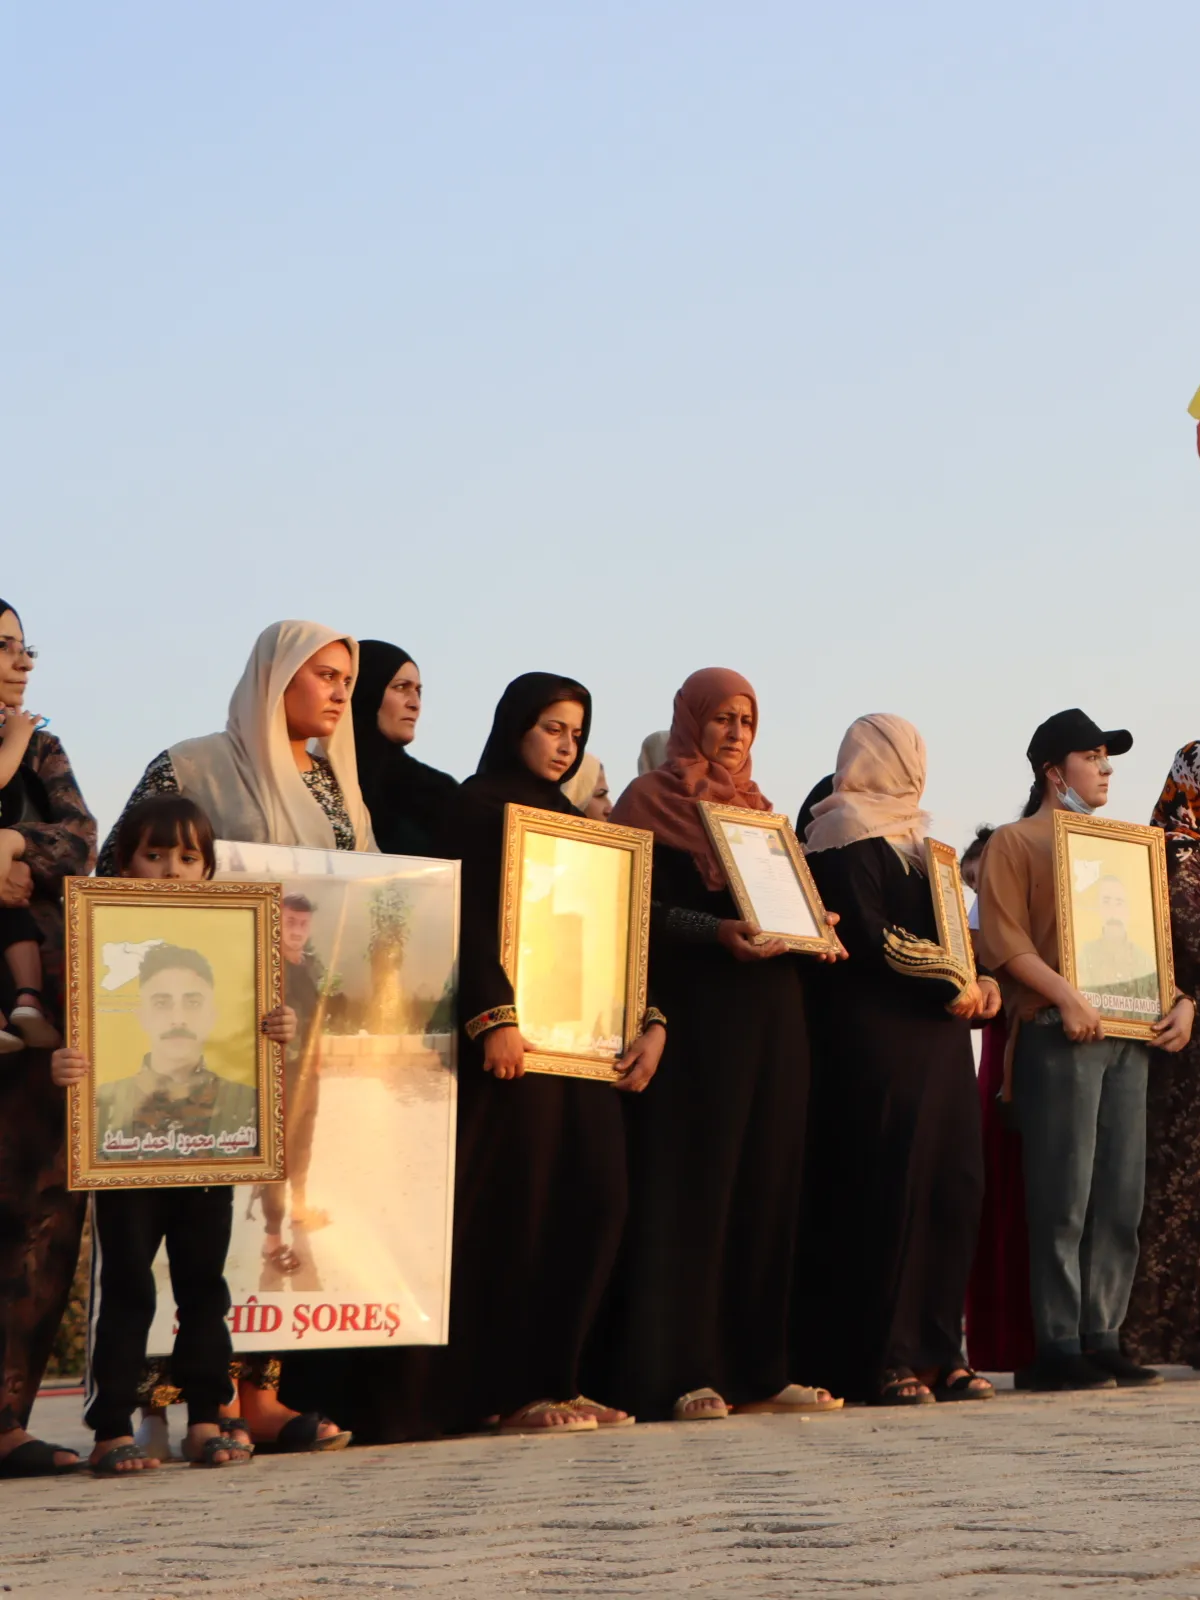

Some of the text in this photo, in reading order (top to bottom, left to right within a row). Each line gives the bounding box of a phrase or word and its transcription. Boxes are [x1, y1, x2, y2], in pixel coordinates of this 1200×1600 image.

[176, 1133, 215, 1155] محمود
[217, 1126, 257, 1154] الشهيد
[292, 1303, 401, 1339] ŞOREŞ
